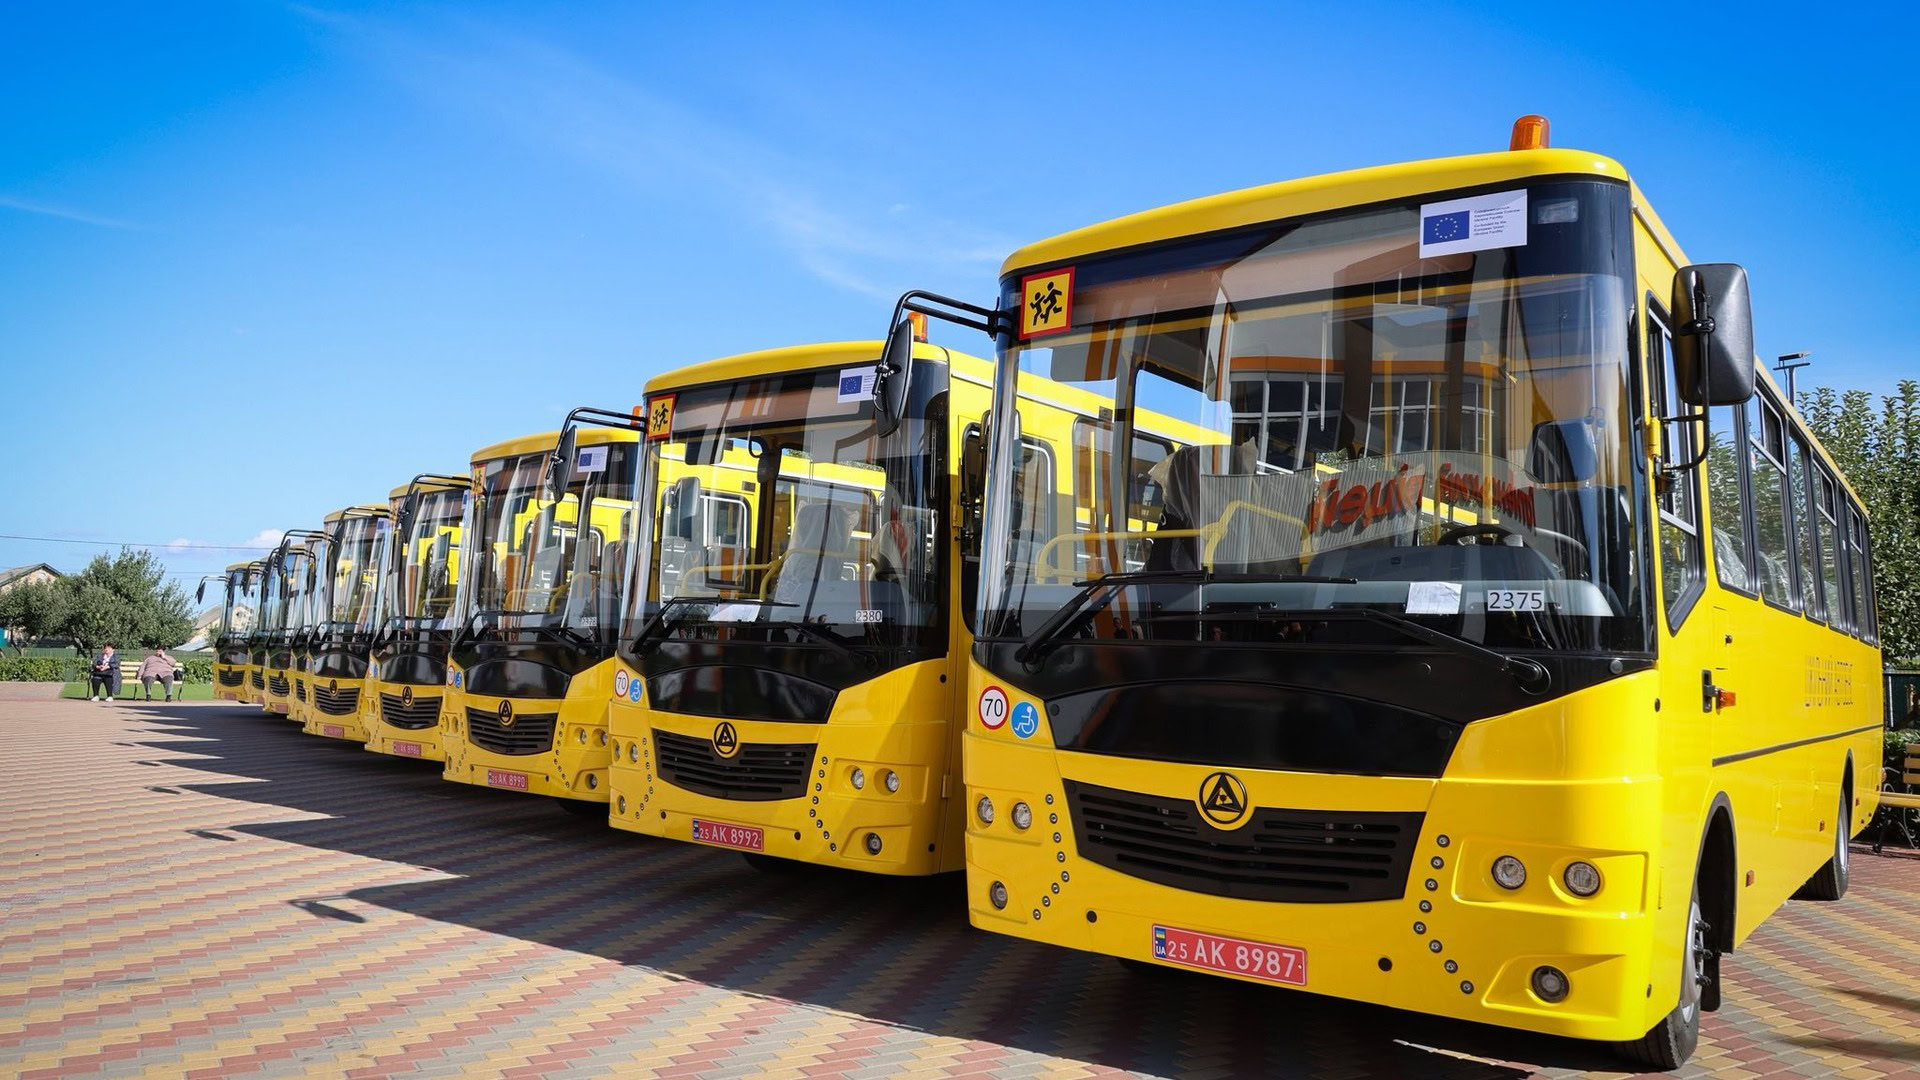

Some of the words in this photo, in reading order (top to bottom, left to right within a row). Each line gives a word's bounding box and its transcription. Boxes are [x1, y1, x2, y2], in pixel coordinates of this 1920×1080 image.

[1489, 592, 1543, 609] 2375
[856, 610, 882, 622] 2380
[617, 676, 627, 690] 70
[984, 698, 1004, 718] 70
[699, 828, 710, 840] 25
[711, 825, 727, 843] AK
[730, 828, 759, 848] 8992
[1155, 946, 1167, 956] UA
[1168, 940, 1188, 960] 25
[1194, 938, 1226, 967] AK
[1235, 945, 1296, 978] 8987
